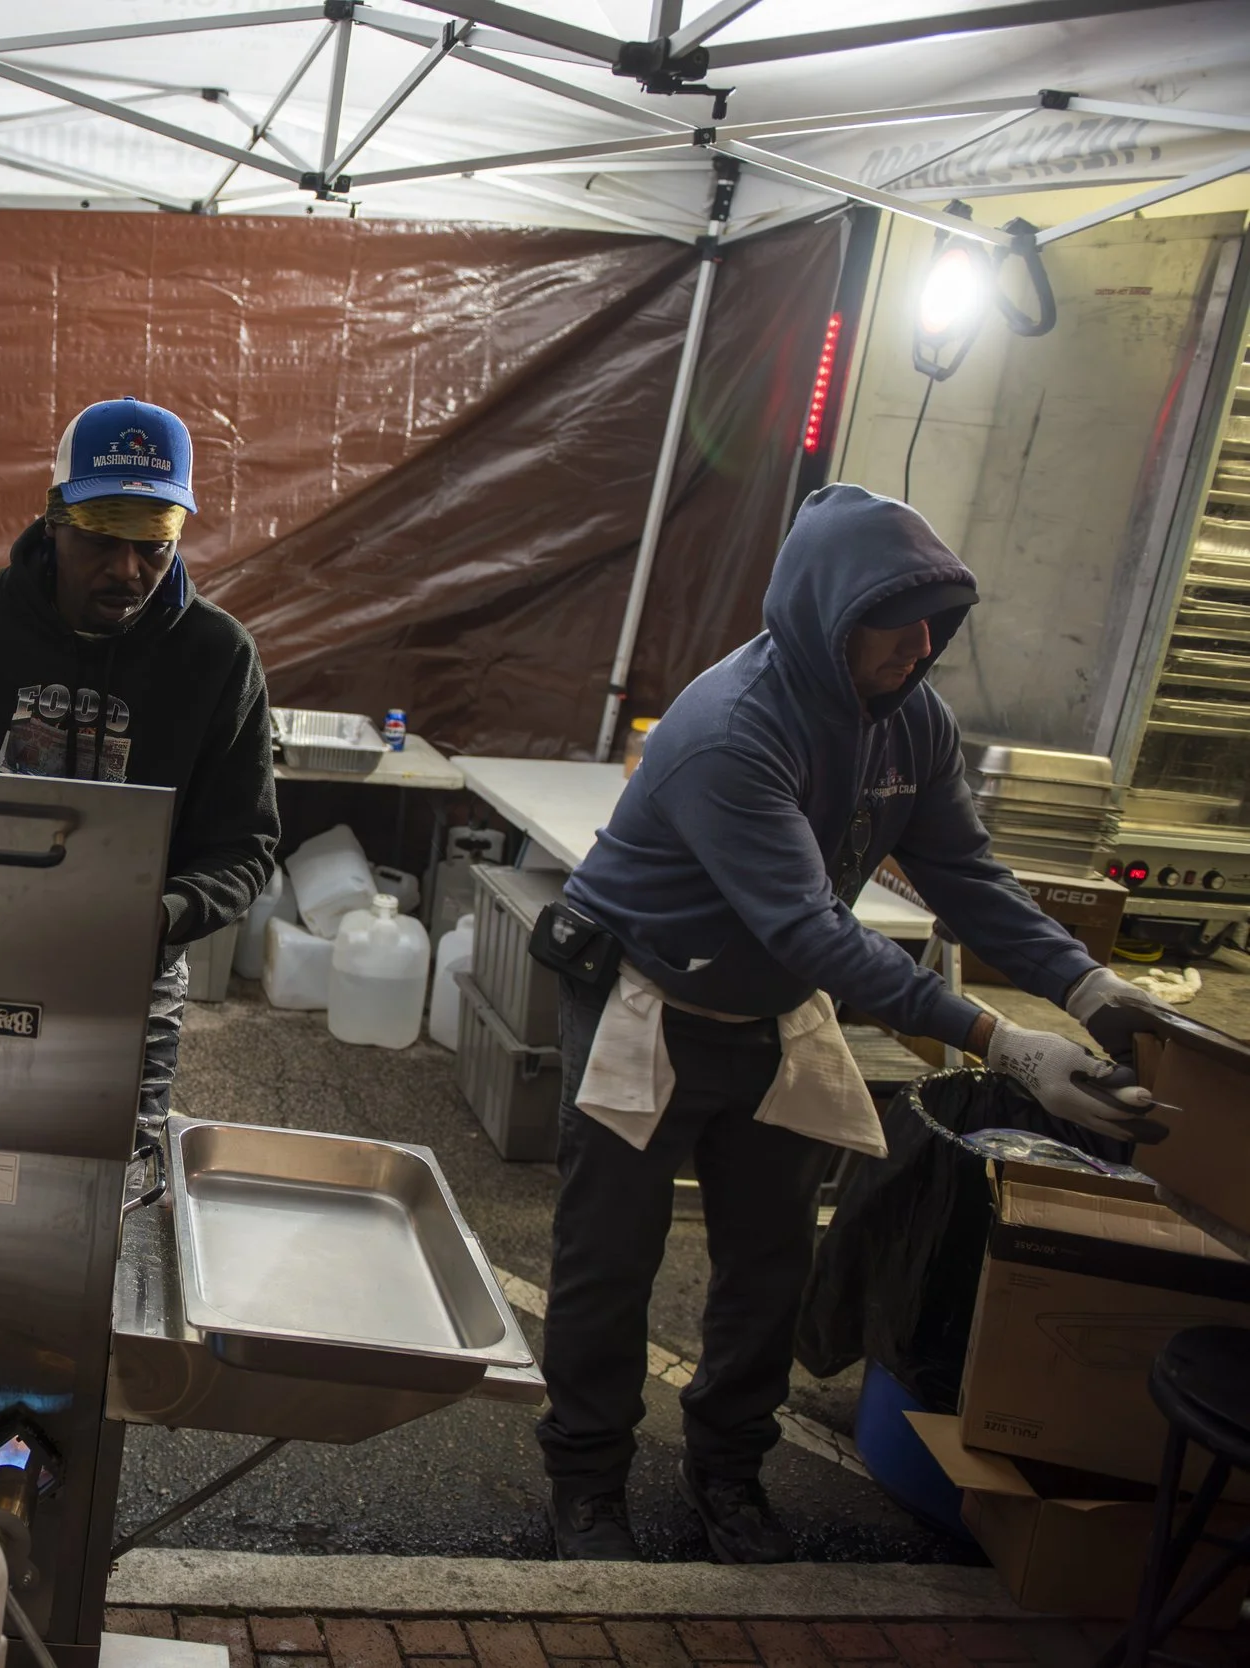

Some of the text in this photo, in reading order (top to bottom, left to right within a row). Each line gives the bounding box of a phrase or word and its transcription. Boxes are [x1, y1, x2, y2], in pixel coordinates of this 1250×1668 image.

[93, 454, 171, 471] WASHINGTON CRAB
[12, 684, 130, 732] FOOD
[1046, 888, 1098, 906] ICED
[984, 1421, 1007, 1433] SIZE
